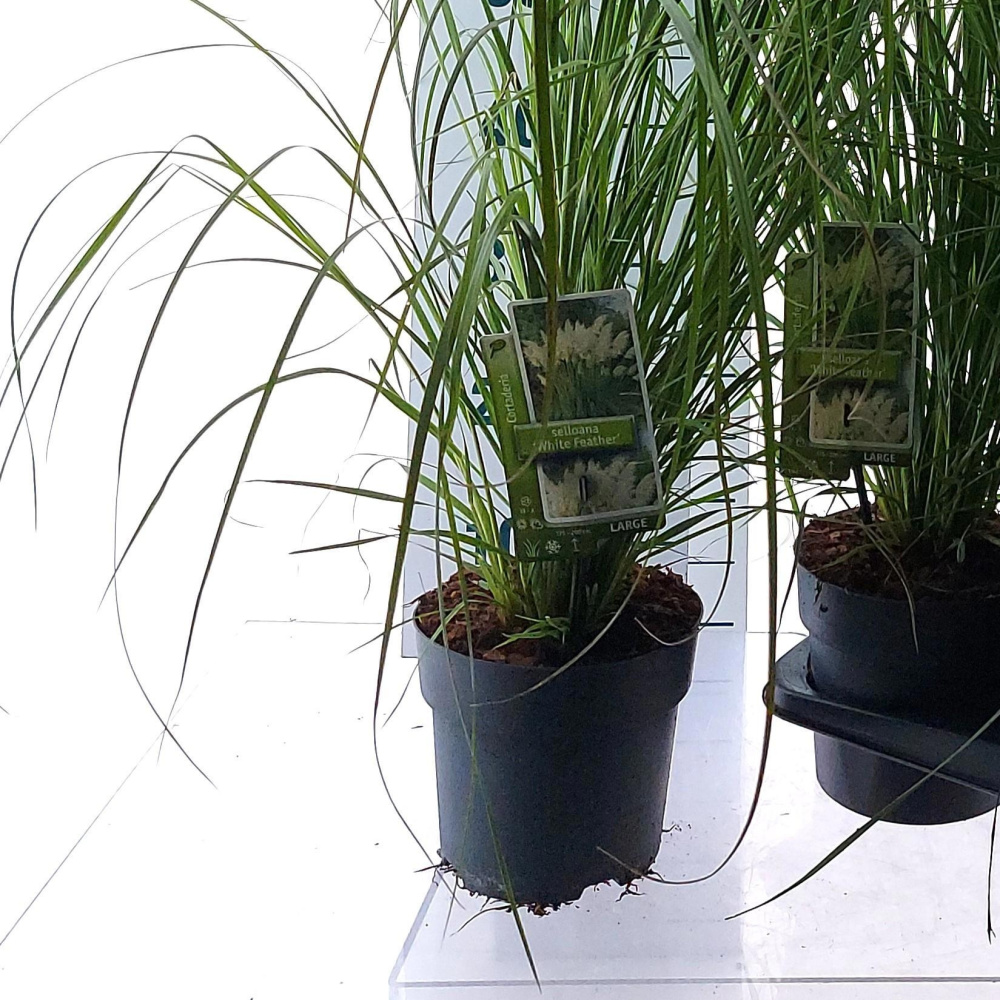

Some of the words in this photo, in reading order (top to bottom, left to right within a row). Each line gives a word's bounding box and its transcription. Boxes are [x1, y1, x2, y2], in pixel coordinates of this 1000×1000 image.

[499, 374, 517, 423] Cortaderia
[551, 424, 600, 437] selloana
[863, 451, 897, 463] LARGE
[609, 517, 649, 533] LARGE
